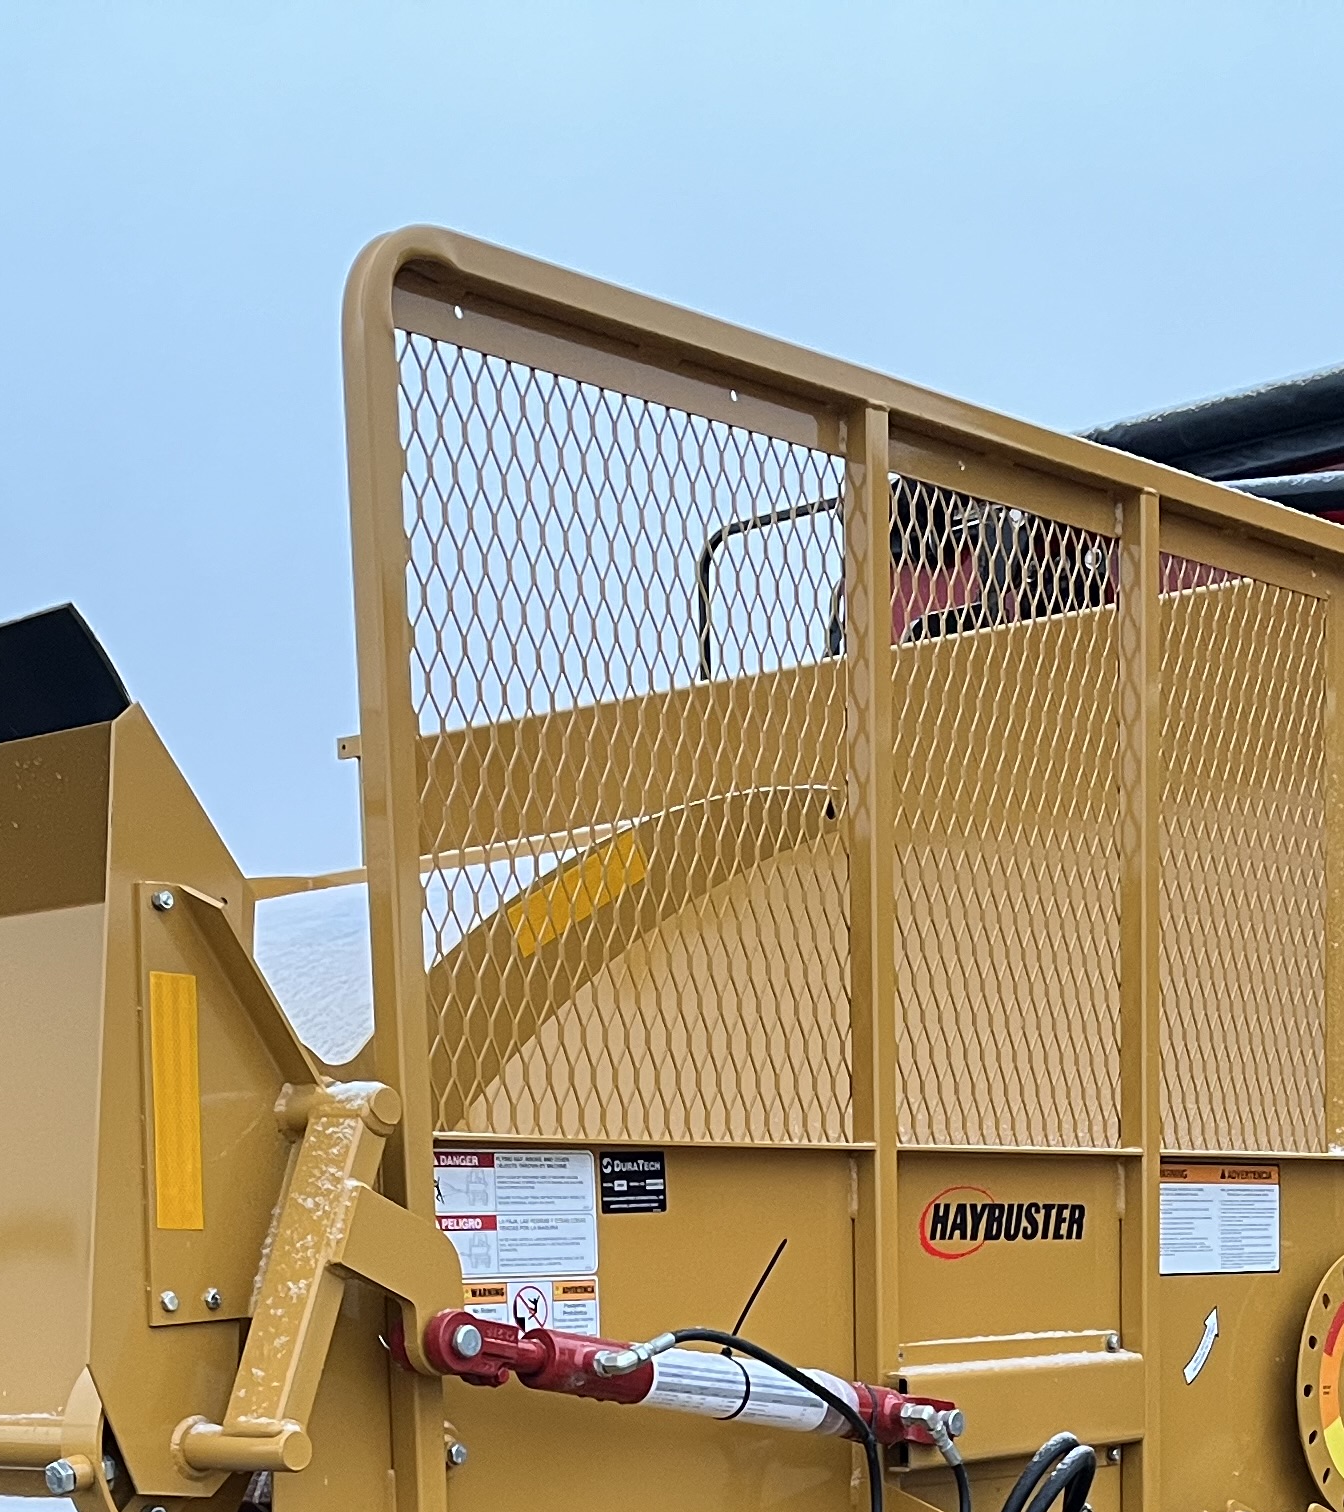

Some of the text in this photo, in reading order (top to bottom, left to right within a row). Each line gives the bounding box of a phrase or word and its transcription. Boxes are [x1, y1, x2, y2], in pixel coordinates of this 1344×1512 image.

[439, 1155, 479, 1166] DANGER
[441, 1218, 483, 1229] PELIGRO
[929, 1202, 1086, 1242] HAYBUSTER
